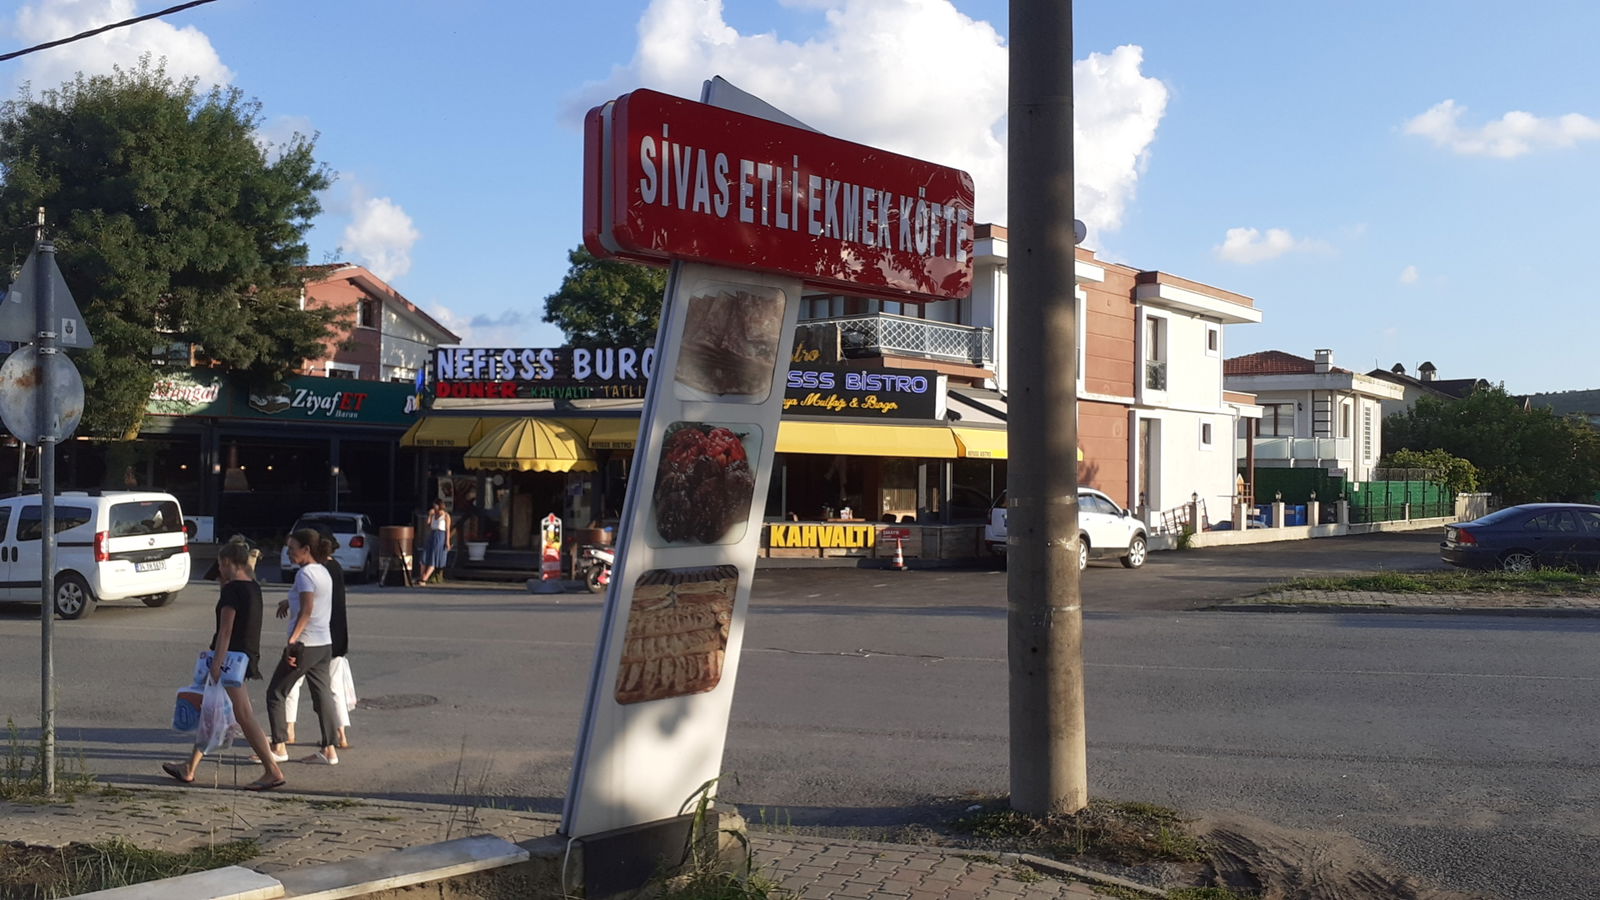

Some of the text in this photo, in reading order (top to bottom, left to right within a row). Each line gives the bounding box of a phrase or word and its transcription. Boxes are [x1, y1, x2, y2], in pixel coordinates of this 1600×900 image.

[639, 123, 730, 218] SİVAS
[739, 154, 799, 231] ETLİ
[808, 174, 893, 249] EKMEK
[787, 370, 836, 389] SSS
[291, 388, 368, 416] ZiyafET
[849, 397, 859, 408] &
[769, 524, 876, 549] KAHVALTI
